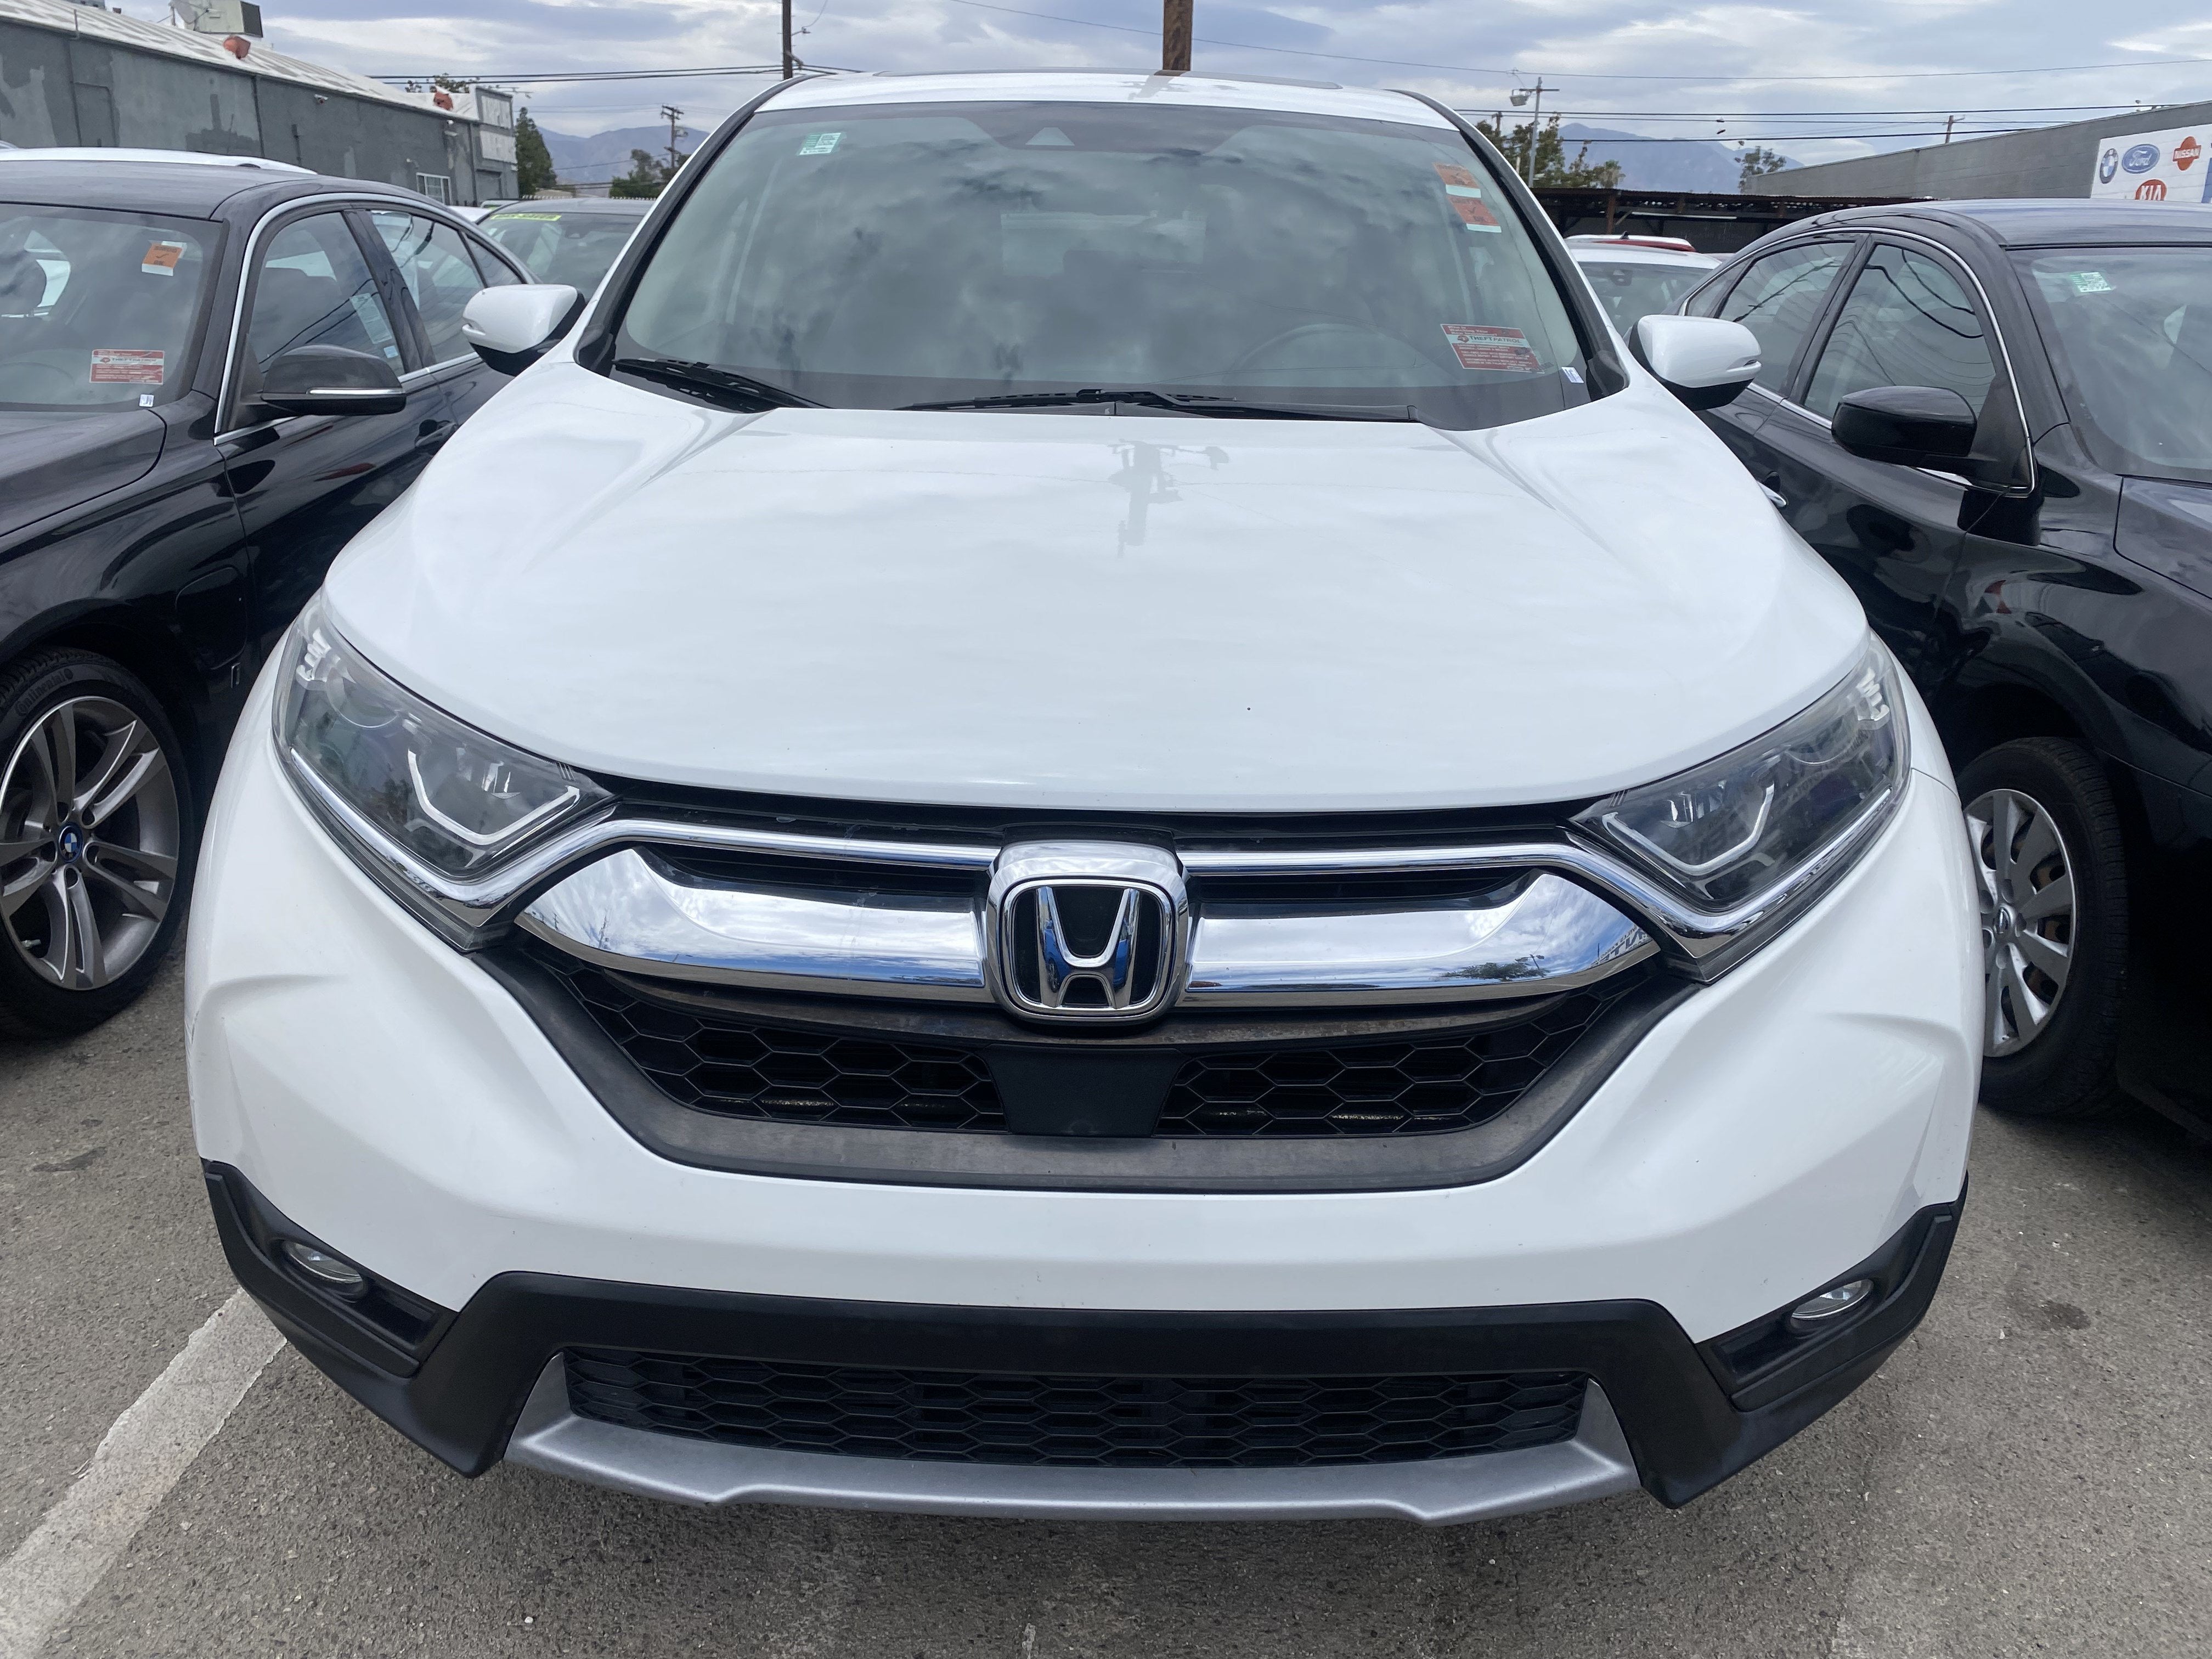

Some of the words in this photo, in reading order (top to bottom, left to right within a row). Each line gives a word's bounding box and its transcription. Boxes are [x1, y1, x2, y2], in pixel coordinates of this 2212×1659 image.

[2129, 150, 2153, 167] Ford
[2175, 148, 2200, 159] NISSAN
[2140, 185, 2162, 201] KIA
